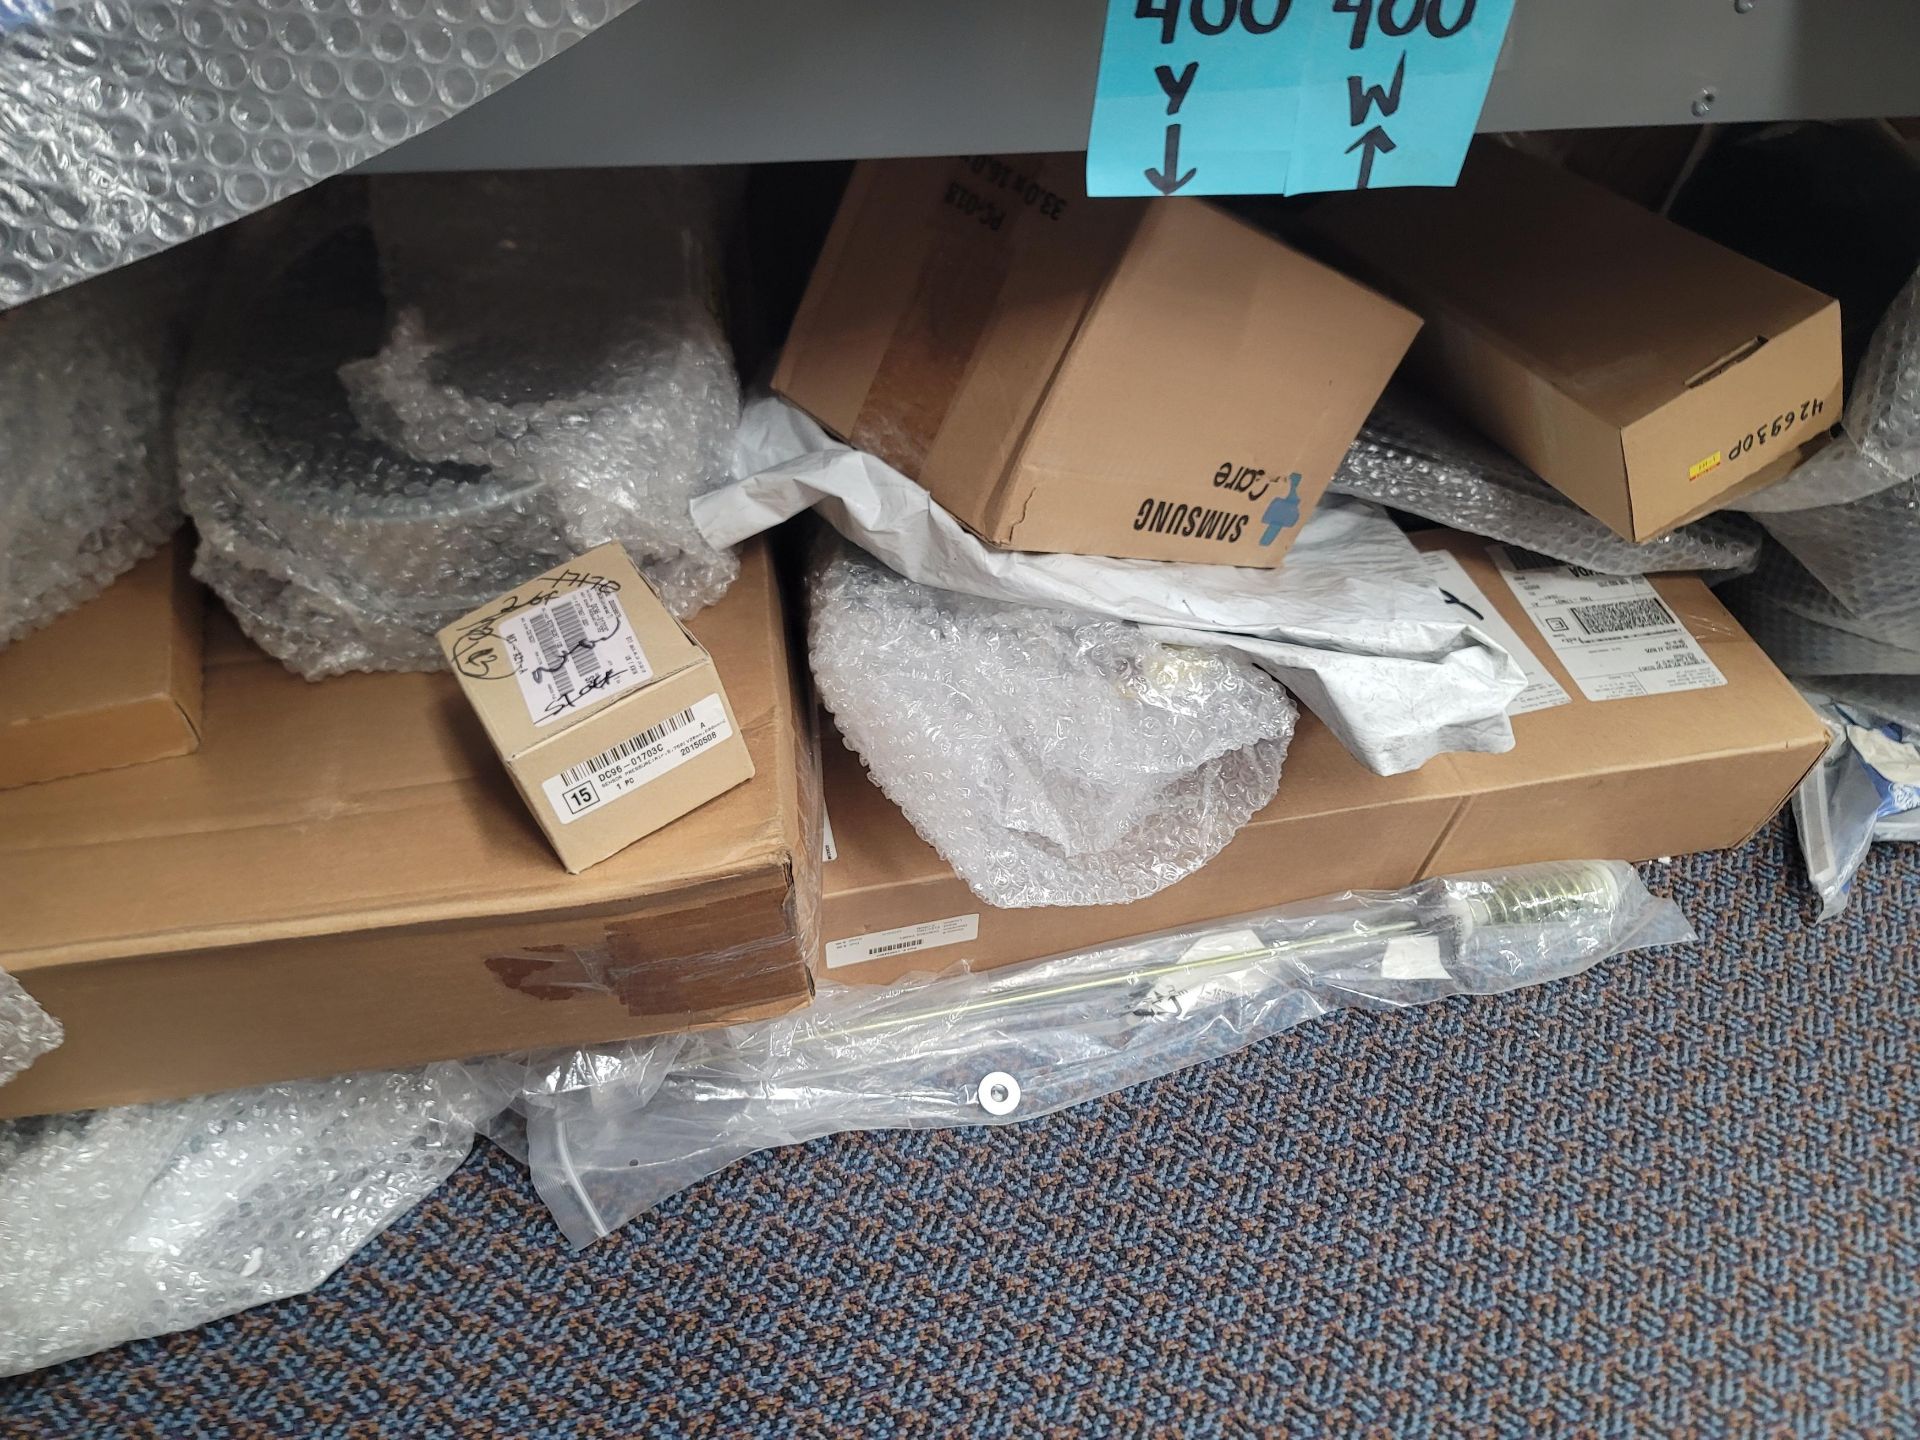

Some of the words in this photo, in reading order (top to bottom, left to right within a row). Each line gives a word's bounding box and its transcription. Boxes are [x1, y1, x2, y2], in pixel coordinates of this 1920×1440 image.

[1135, 0, 1291, 45] 400
[1332, 0, 1477, 49] 400
[1154, 62, 1198, 116] Y
[1347, 49, 1406, 127] W
[1728, 398, 1823, 461] 426930P
[1213, 462, 1269, 501] Care
[1133, 498, 1249, 543] SAMSUNG
[598, 743, 665, 782] DC96-01703C
[571, 787, 592, 807] 15
[616, 783, 622, 791] 1
